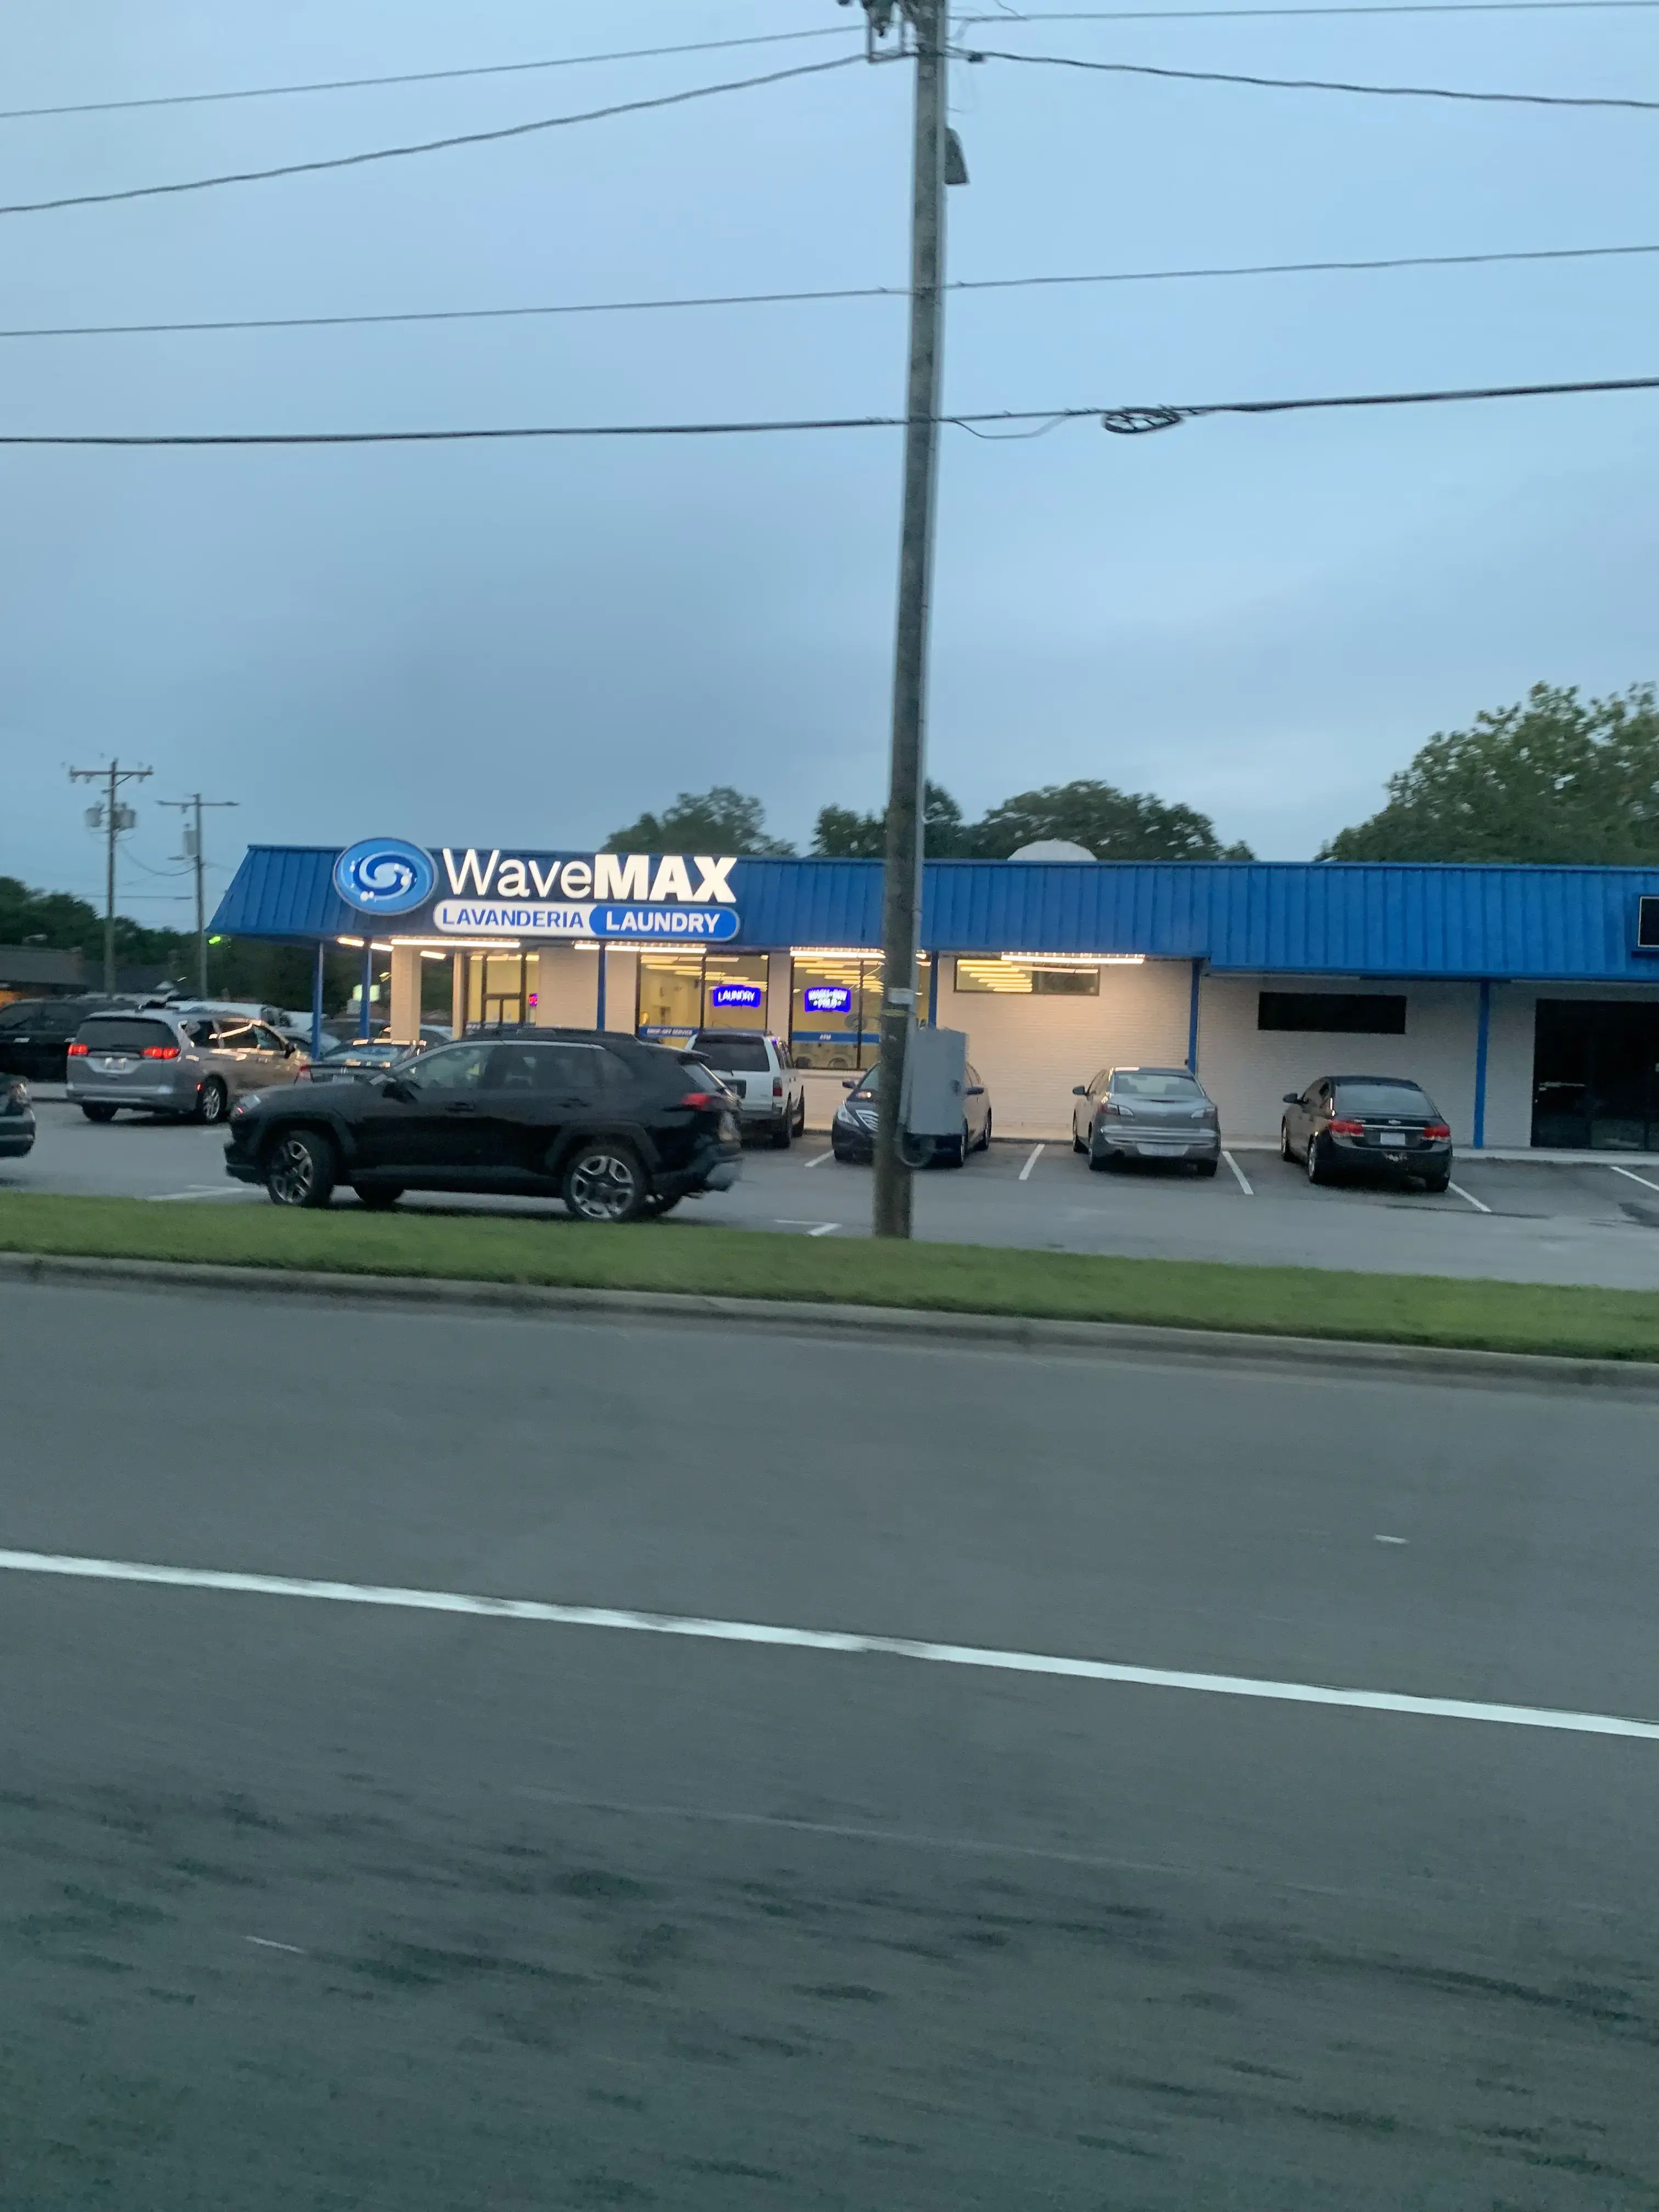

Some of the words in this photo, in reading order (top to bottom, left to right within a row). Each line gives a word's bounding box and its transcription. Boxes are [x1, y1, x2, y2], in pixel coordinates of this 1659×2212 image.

[442, 848, 737, 904] WaveMAX
[442, 907, 584, 928] LAVANDERIA
[606, 911, 720, 933] LAUNDRY
